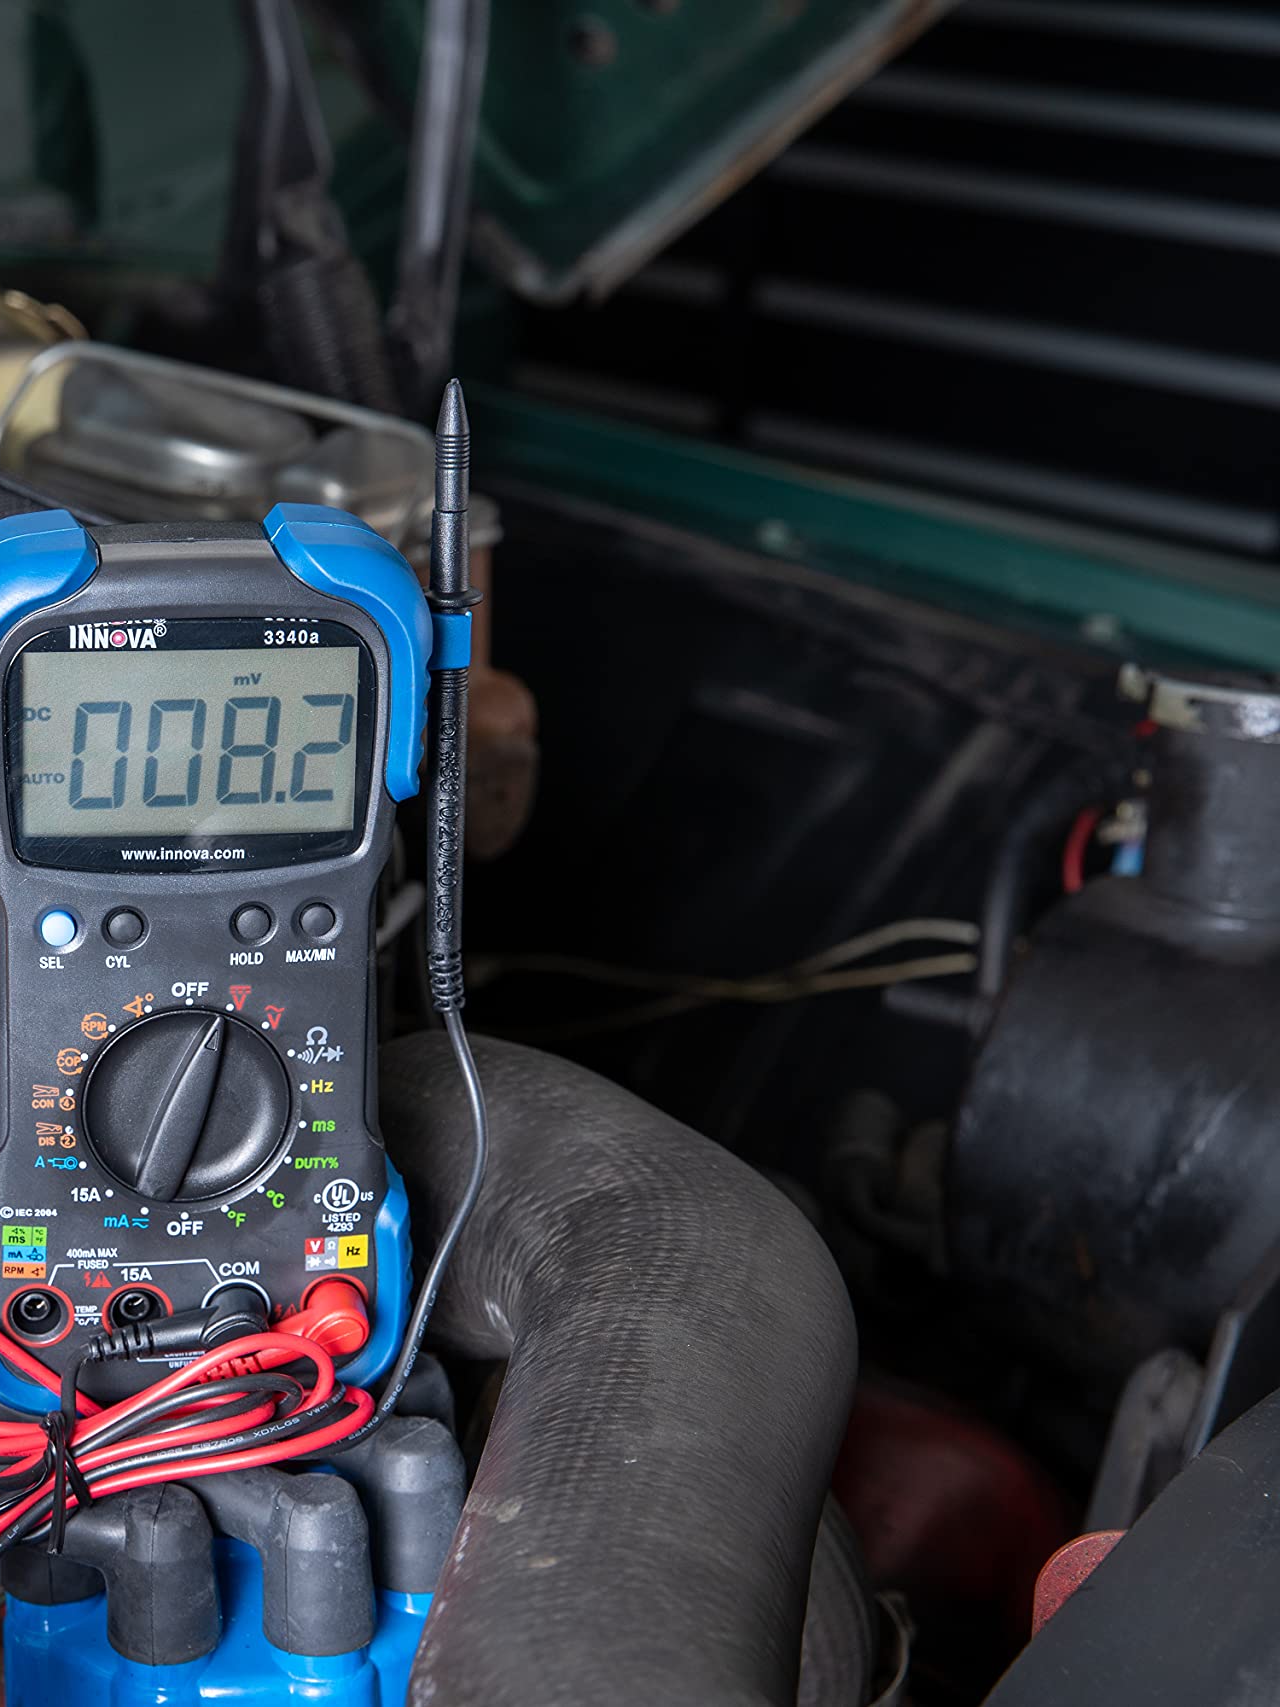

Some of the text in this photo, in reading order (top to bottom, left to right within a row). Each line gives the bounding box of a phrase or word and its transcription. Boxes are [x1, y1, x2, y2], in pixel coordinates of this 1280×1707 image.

[263, 629, 320, 645] 3340a
[233, 672, 262, 686] mV
[23, 706, 52, 722] DC
[69, 693, 355, 810] 008.2
[21, 772, 65, 785] AUTO
[121, 847, 245, 862] www.innova.com
[105, 955, 131, 969] CYL
[229, 952, 264, 966] HOLD
[285, 948, 336, 963] MAX/MIN
[39, 956, 64, 969] SEL
[171, 982, 209, 997] OFF
[81, 1020, 107, 1032] RPM
[56, 1055, 82, 1067] COP
[311, 1079, 334, 1094] Hz
[31, 1099, 54, 1109] CON
[312, 1120, 336, 1133] ms
[38, 1137, 56, 1147] DIS
[34, 1155, 45, 1168] A
[294, 1157, 339, 1170] DUTY%
[70, 1187, 101, 1202] 15A
[360, 1191, 374, 1201] US
[15, 1208, 33, 1217] IEC
[322, 1212, 361, 1223] LISTED
[103, 1214, 130, 1228] mA
[166, 1221, 204, 1236] OFF
[8, 1235, 26, 1244] ms
[310, 1240, 321, 1252] V
[7, 1250, 23, 1259] mA
[66, 1248, 118, 1259] 400mA MAX
[346, 1246, 361, 1256] Hz
[4, 1266, 25, 1274] RPM
[77, 1260, 109, 1270] FUSED
[219, 1261, 260, 1276] COM
[121, 1267, 152, 1281] 15A
[74, 1305, 98, 1314] TEMP
